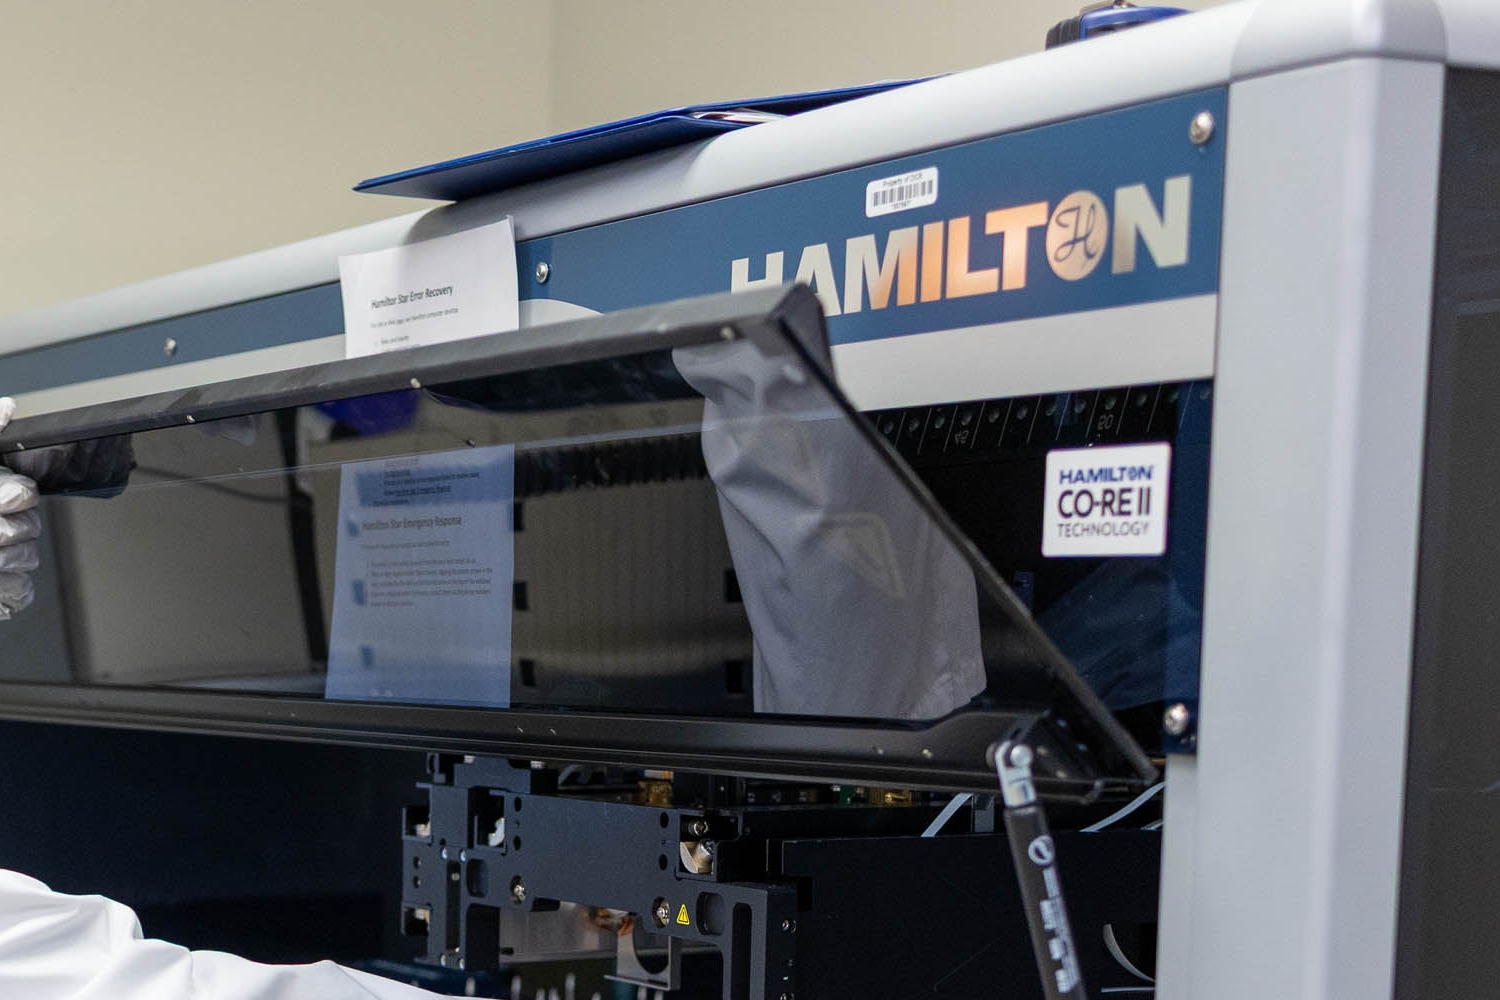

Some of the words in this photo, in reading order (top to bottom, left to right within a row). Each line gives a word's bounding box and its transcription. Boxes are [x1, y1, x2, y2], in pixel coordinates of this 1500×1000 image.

[410, 290, 424, 302] Error
[425, 285, 453, 298] Recovery
[1059, 465, 1154, 485] HAMILTON
[1057, 487, 1132, 519] CO-RE
[1057, 521, 1149, 538] TECHNOLOGY
